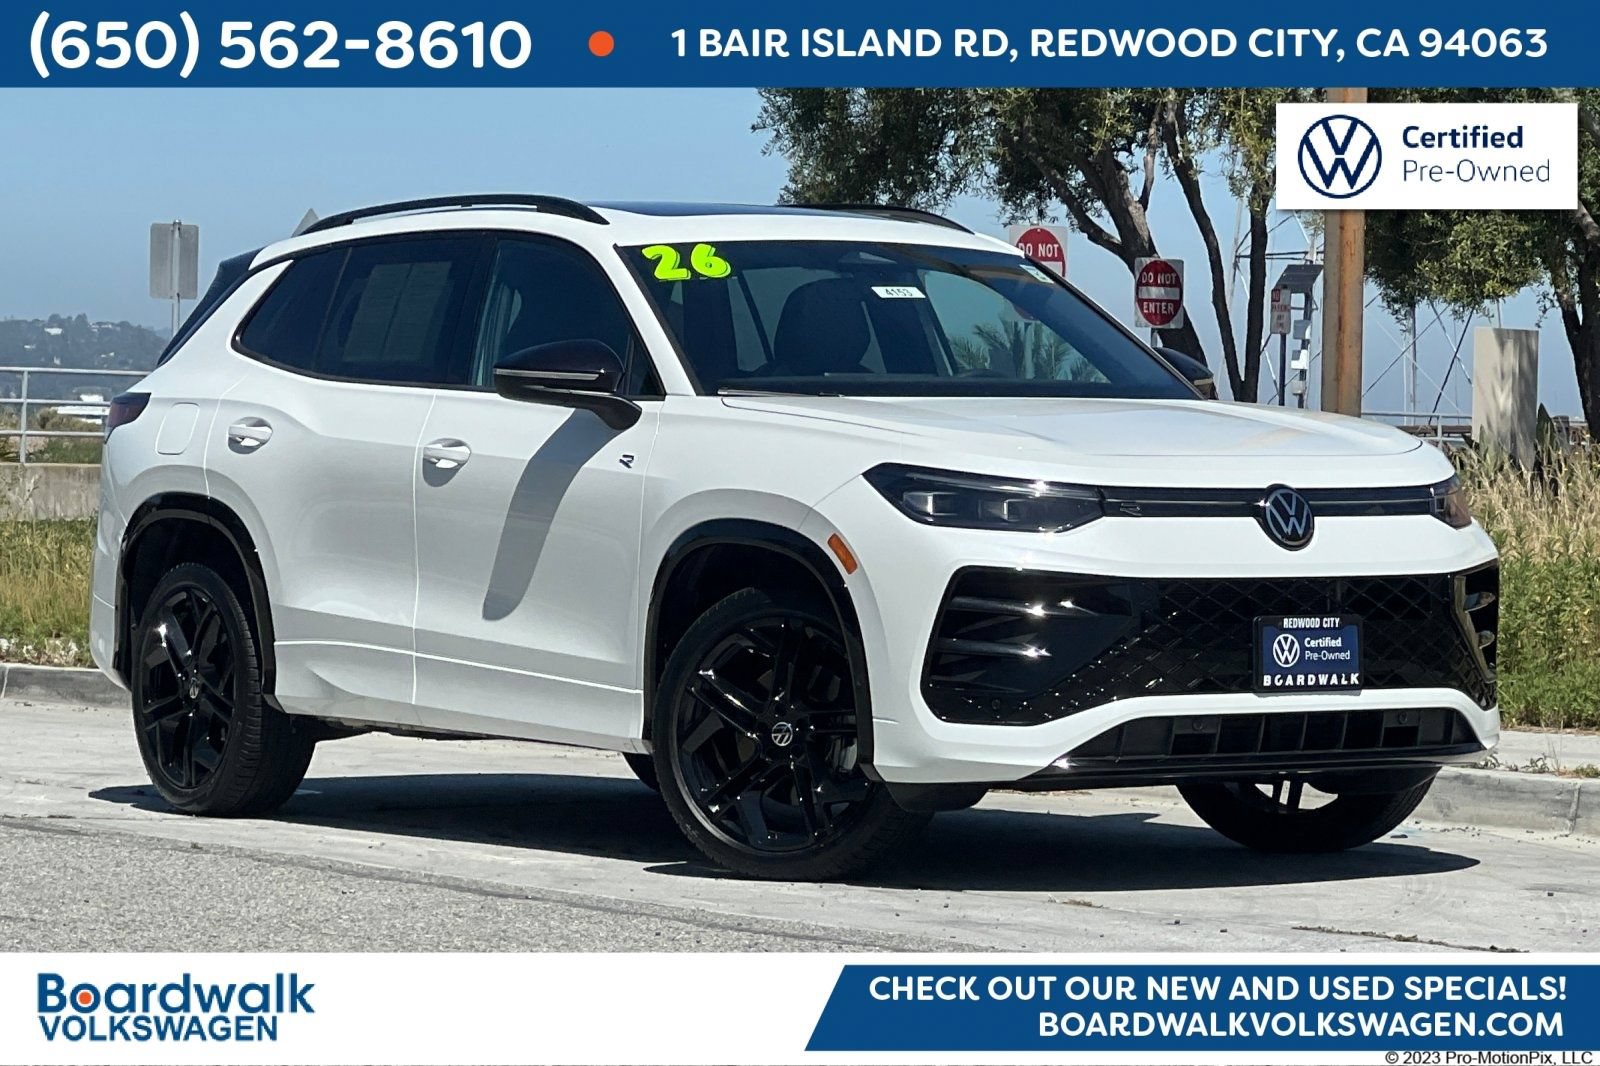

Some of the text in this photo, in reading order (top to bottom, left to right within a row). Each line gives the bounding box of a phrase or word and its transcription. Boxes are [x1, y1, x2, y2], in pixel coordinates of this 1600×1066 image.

[1018, 242, 1059, 258] DO NOT
[641, 243, 731, 281] 26
[1141, 272, 1177, 285] DO NOT
[884, 288, 913, 297] 4153
[1143, 302, 1175, 315] ENTER
[1283, 618, 1340, 629] REDWOOD CITY
[1304, 637, 1342, 648] Certified
[1305, 650, 1350, 660] Pre-Owned
[1263, 673, 1359, 687] BOARDWALK
